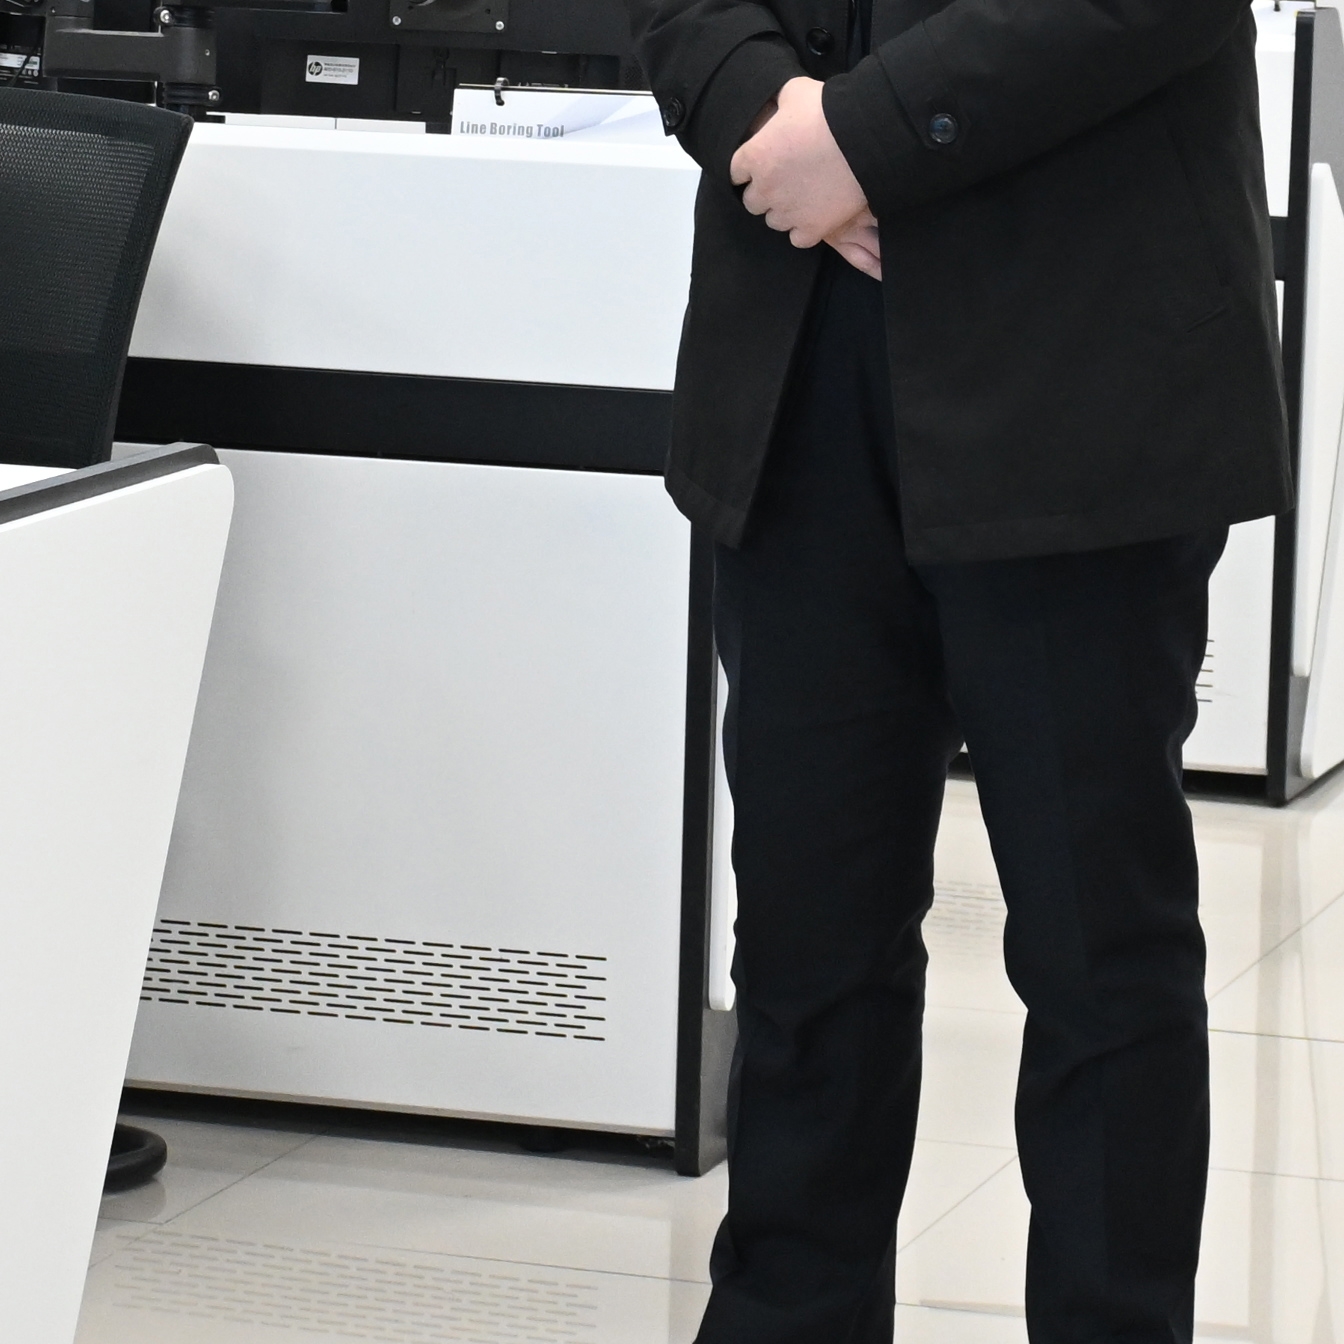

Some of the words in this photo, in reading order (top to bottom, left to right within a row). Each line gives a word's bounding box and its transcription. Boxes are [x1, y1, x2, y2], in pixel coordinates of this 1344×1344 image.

[460, 121, 487, 135] Line
[490, 122, 534, 138] Boring
[537, 124, 565, 138] Tool
